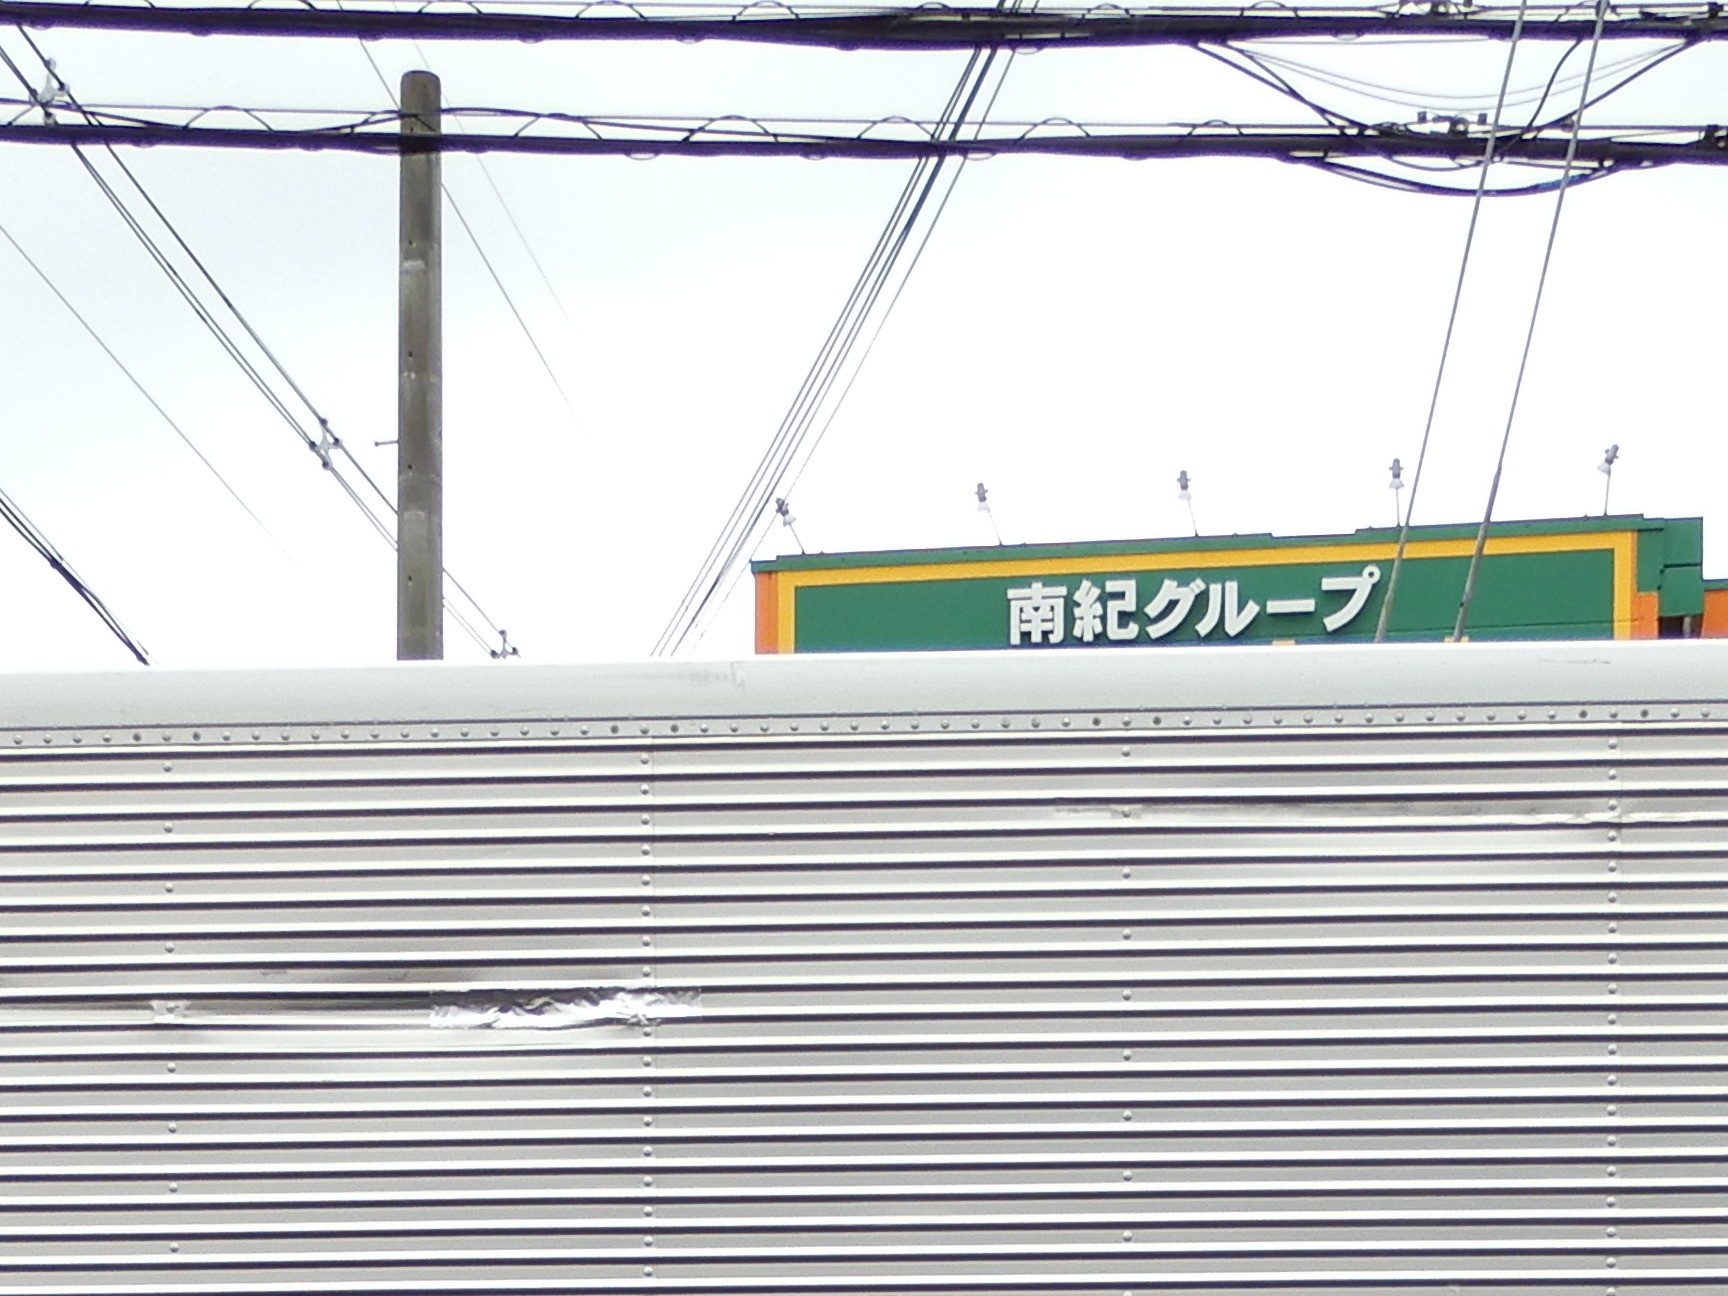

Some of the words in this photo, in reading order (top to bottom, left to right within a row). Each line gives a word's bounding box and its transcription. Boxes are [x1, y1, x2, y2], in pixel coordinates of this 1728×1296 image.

[1007, 565, 1382, 646] 南紀グループ
